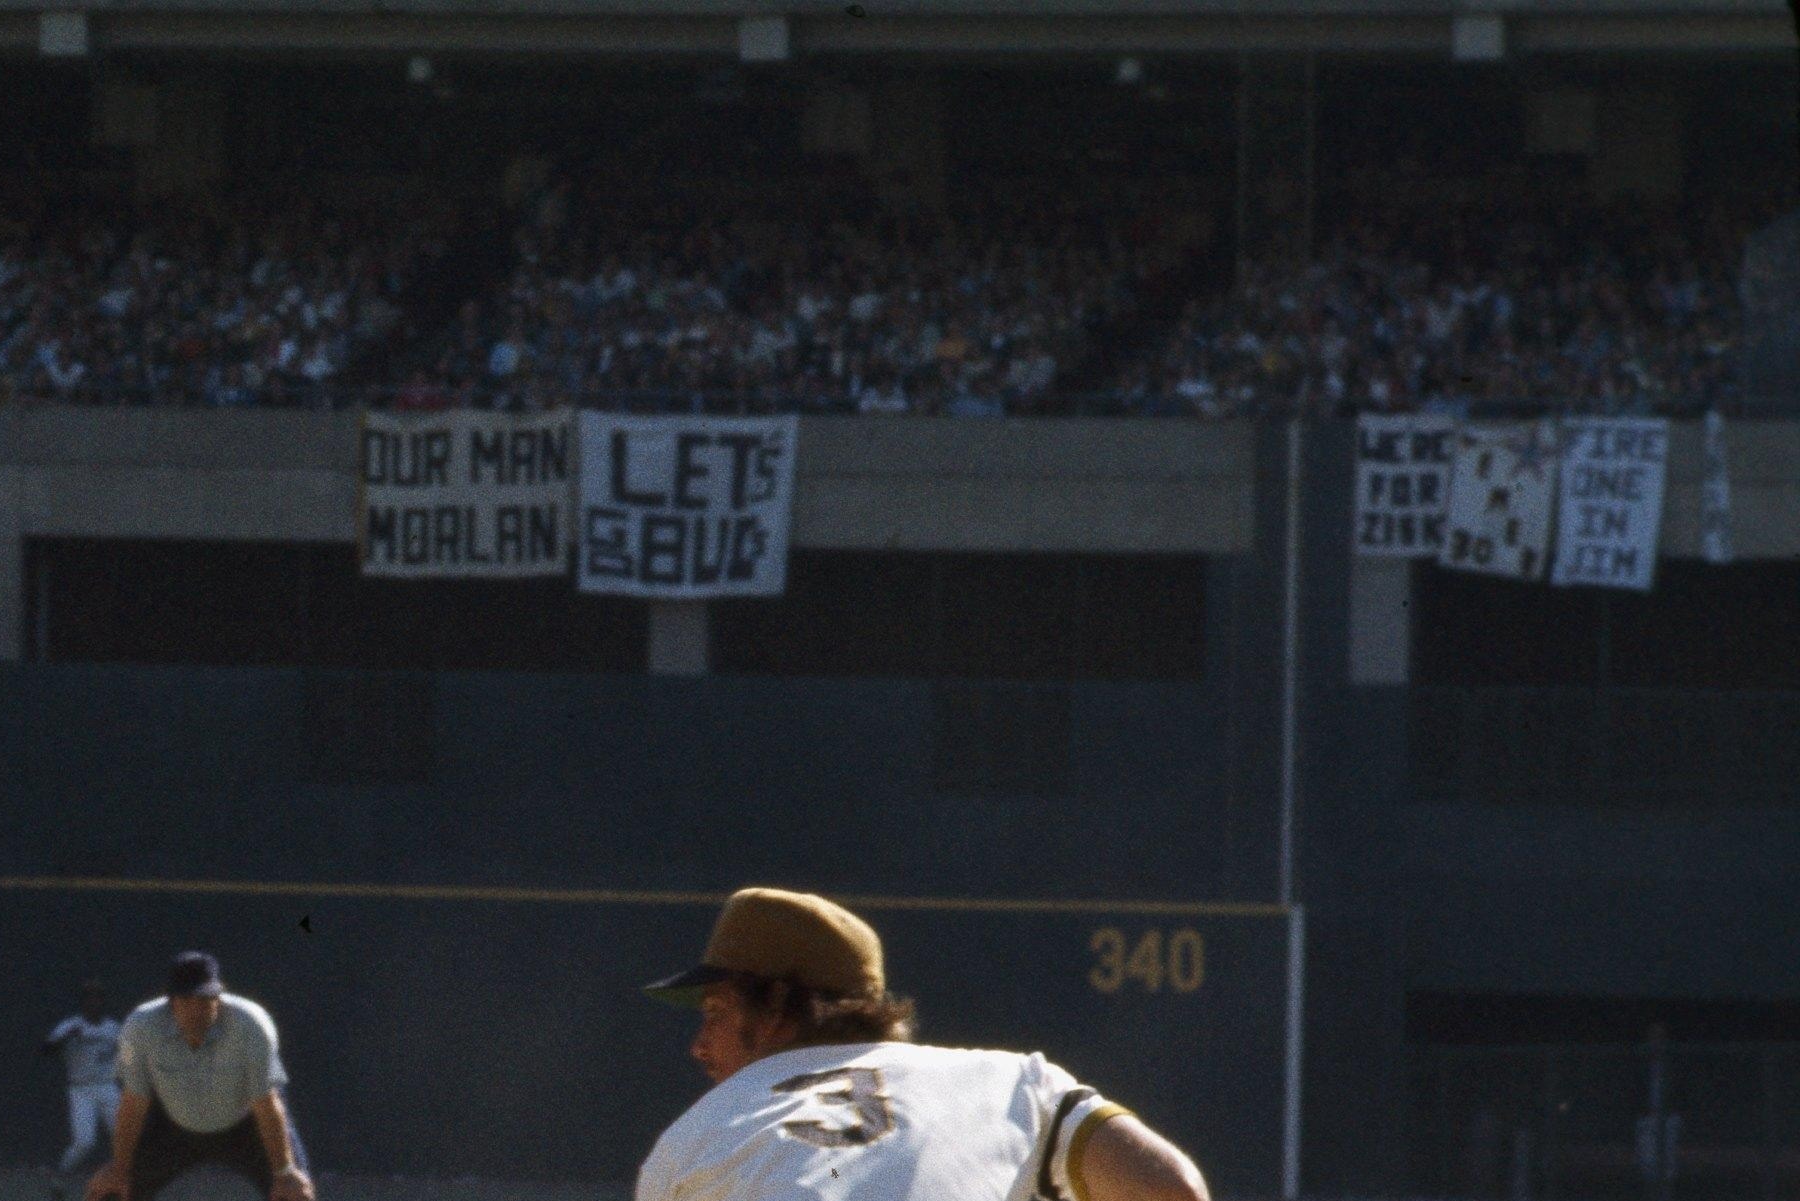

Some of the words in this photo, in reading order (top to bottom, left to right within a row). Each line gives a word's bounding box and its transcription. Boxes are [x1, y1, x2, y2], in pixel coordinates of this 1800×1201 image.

[360, 428, 454, 487] OUR
[469, 424, 569, 485] MAN
[1369, 472, 1440, 507] FOR
[1089, 927, 1204, 993] 340
[772, 1067, 895, 1148] 3
